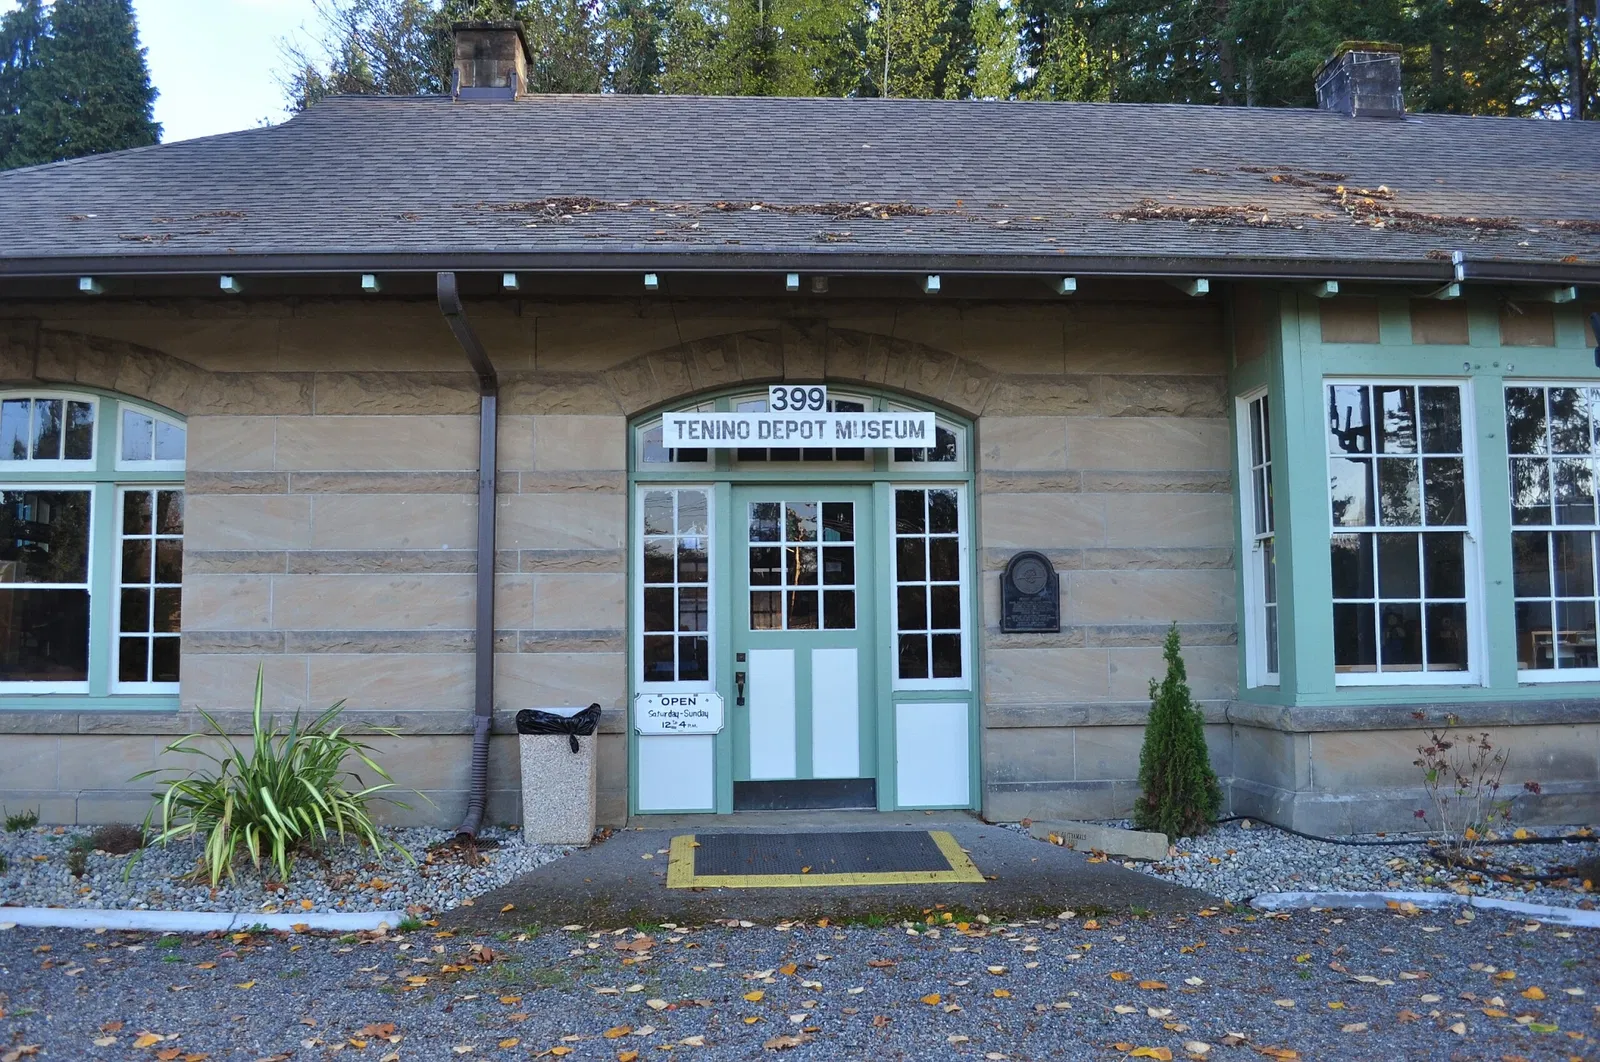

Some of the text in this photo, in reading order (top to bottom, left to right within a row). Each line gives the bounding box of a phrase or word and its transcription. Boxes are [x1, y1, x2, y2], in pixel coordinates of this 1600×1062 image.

[771, 387, 825, 411] 399
[673, 420, 925, 440] TENINO DEPOT MUSEUM
[661, 697, 696, 706] OPEN
